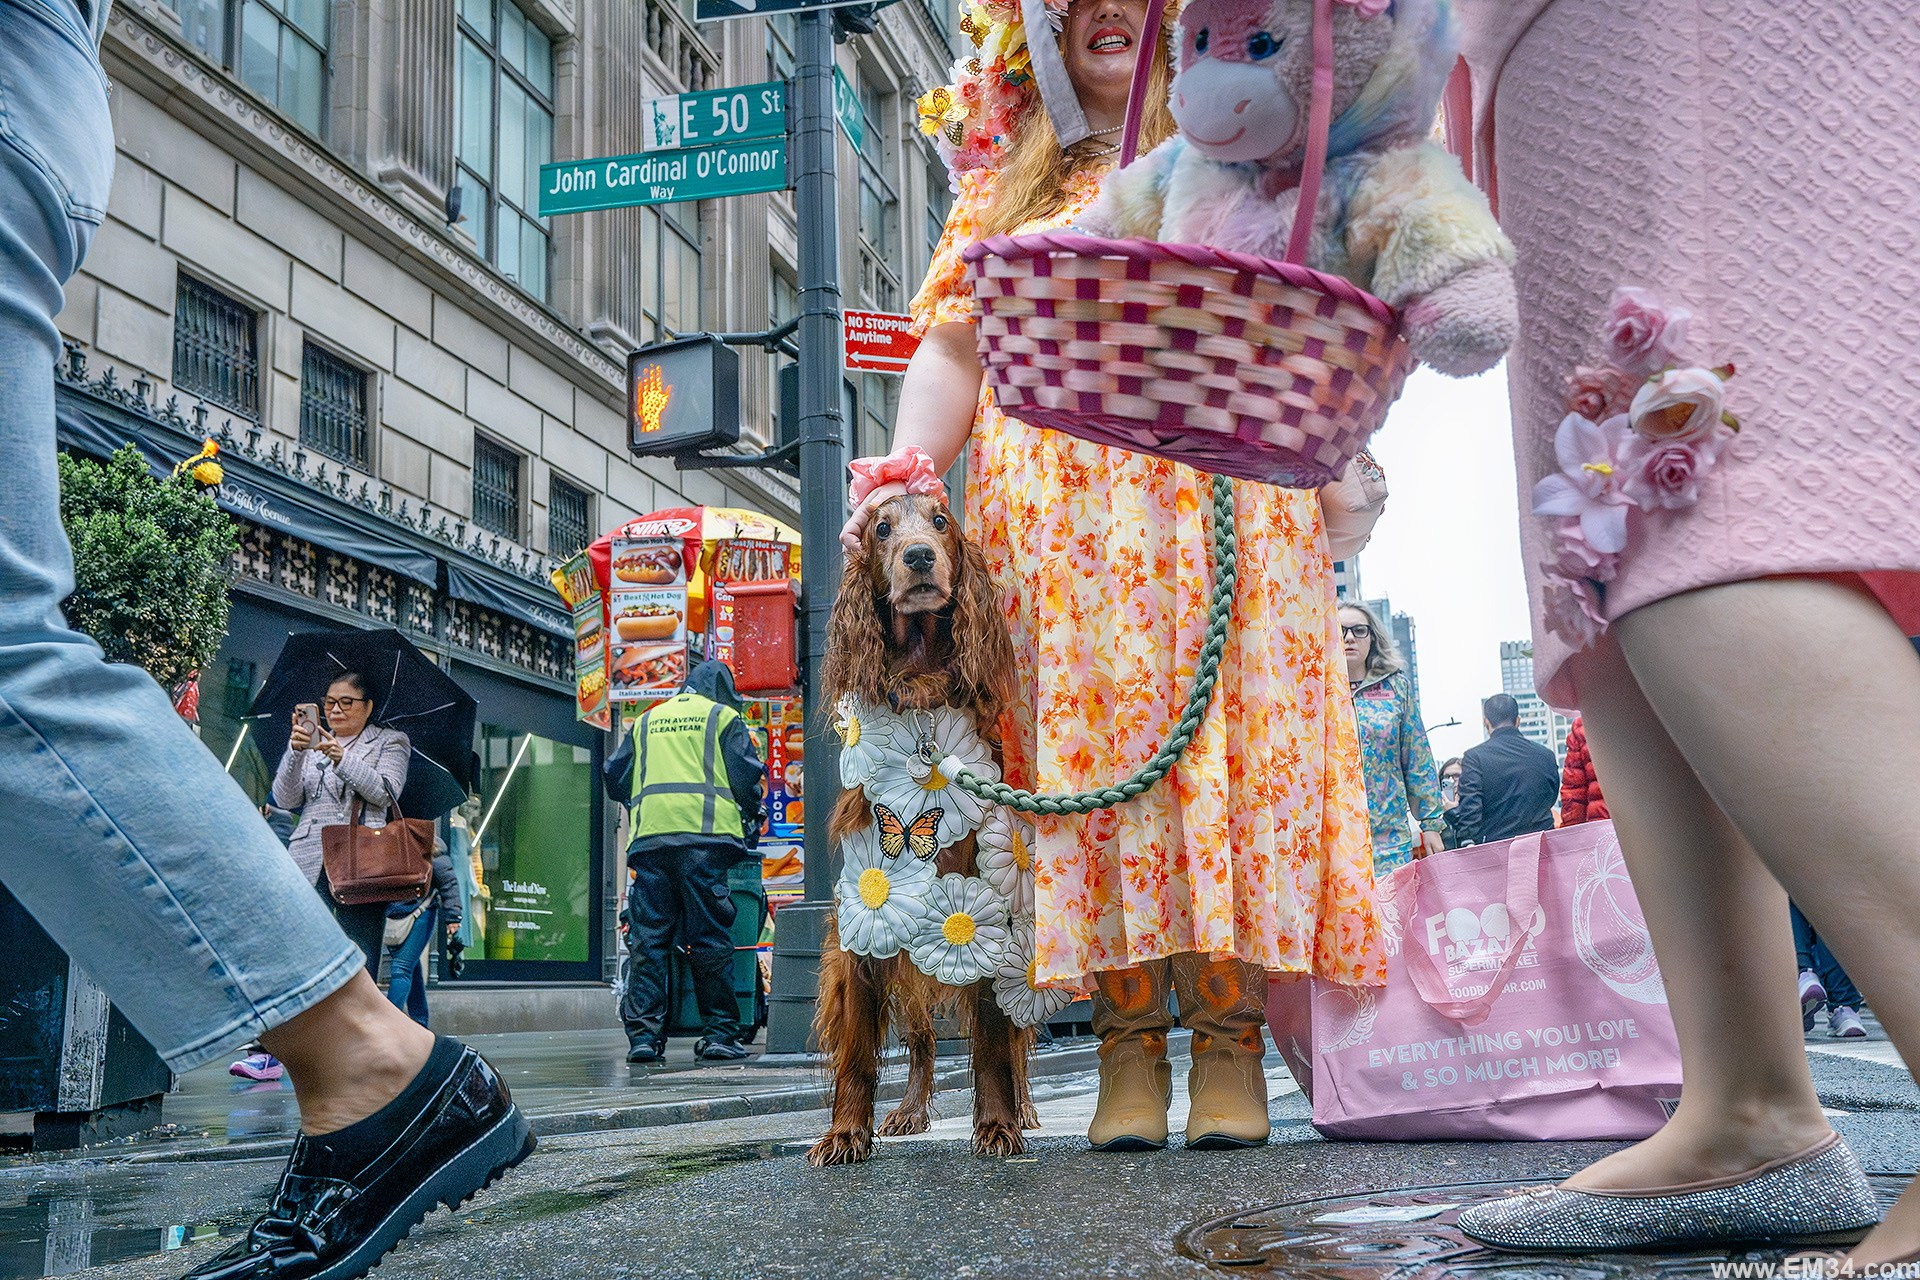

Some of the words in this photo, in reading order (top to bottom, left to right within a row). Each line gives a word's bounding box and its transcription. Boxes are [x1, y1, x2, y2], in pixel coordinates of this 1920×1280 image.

[682, 99, 699, 139] E
[712, 93, 749, 137] 50
[761, 90, 781, 115] St
[549, 167, 596, 195] John
[605, 156, 687, 188] Cardinal
[697, 149, 779, 178] O'Connor
[650, 186, 675, 200] Way
[848, 316, 863, 328] NO
[849, 329, 893, 345] Anytime
[649, 717, 671, 726] FIFTH
[672, 716, 706, 724] AVENUE
[650, 726, 677, 734] CLEAN
[678, 724, 702, 732] TEAM
[771, 727, 782, 779] HALAL
[1444, 932, 1536, 963] BAZAR
[1368, 1031, 1522, 1068] EVERYTHING
[1526, 1023, 1581, 1048] YOU
[1585, 1019, 1639, 1042] LOVE
[1401, 1071, 1418, 1090] &
[1423, 1066, 1458, 1088] SO
[1464, 1056, 1540, 1083] MUCH
[1545, 1047, 1621, 1075] MORE!
